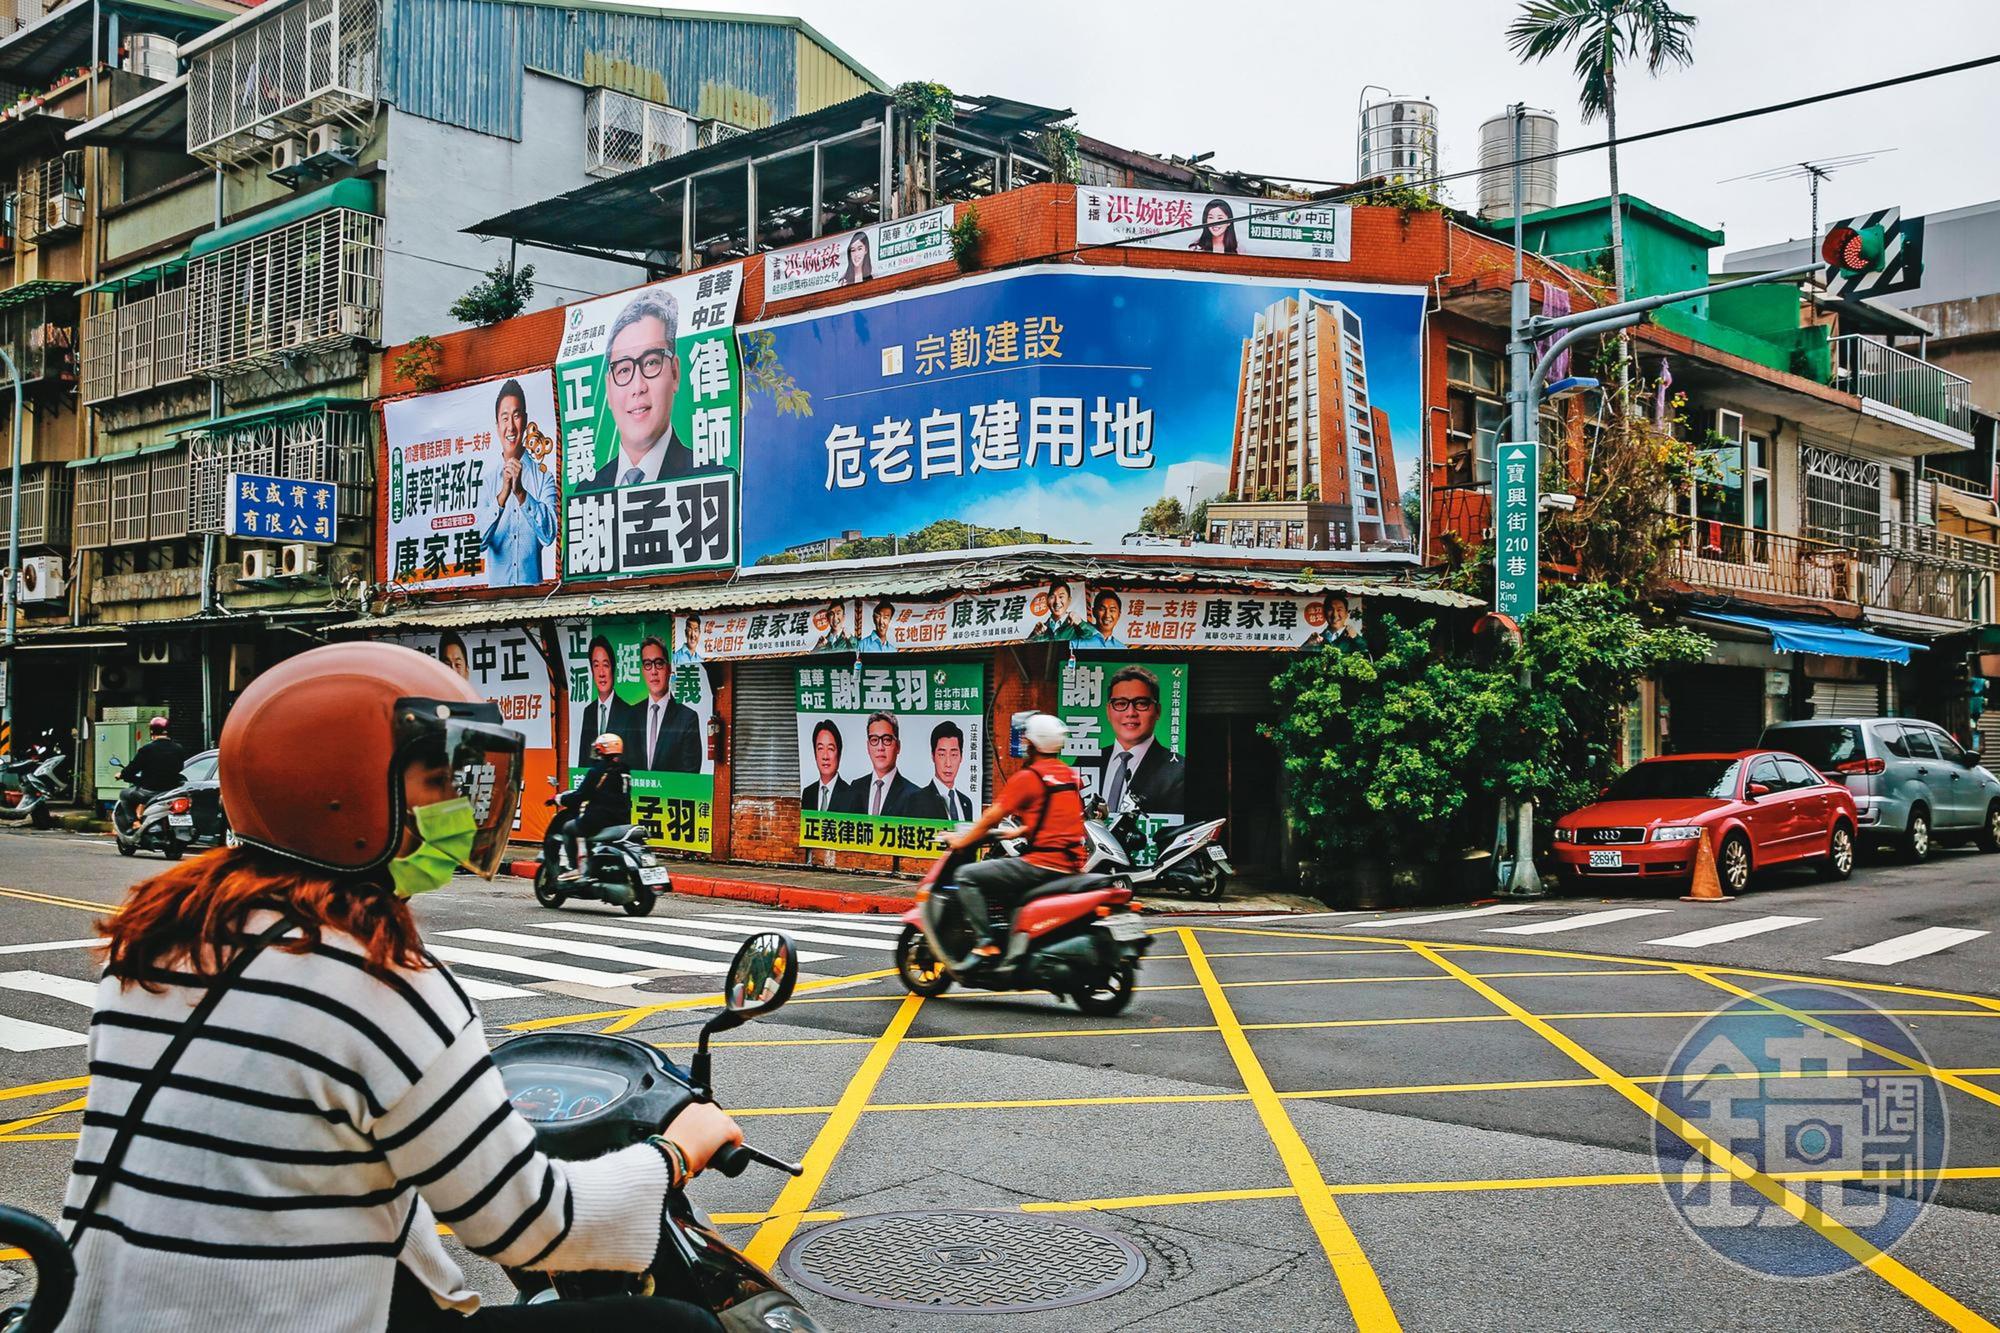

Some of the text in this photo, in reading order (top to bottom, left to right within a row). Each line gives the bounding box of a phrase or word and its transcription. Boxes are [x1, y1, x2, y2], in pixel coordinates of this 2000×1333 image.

[1088, 195, 1100, 221] 主播
[1107, 194, 1193, 227] 洪婉臻
[1306, 211, 1330, 225] 中正
[882, 217, 938, 242] 萬華 中正
[785, 242, 840, 279] 洪婉臻
[697, 269, 734, 301] 萬華
[691, 303, 727, 331] 中正
[915, 316, 1064, 376] 宗勤建設
[689, 337, 731, 469] 律師
[561, 364, 597, 486] 正義
[455, 432, 491, 454] 唯一支持
[824, 396, 1156, 491] 危老自建用地
[404, 459, 484, 517] 康寧祥孫仔
[242, 509, 329, 539] 有限公司
[568, 479, 729, 575] 謝孟羽
[394, 529, 483, 581] 康家瑋
[1500, 581, 1515, 590] Bao
[1500, 592, 1517, 603] Xing
[747, 610, 810, 640] 康家瑋
[952, 595, 1027, 628] 康家瑋
[1127, 600, 1197, 618] 瑋一支持
[1202, 598, 1298, 630] 康家瑋
[970, 629, 981, 638] 中正
[1205, 632, 1293, 641] 萬華 中正 市議員候選人
[473, 638, 529, 684] 中正
[567, 625, 590, 703] 正派
[616, 643, 641, 683] 挺
[799, 669, 825, 687] 萬華
[830, 668, 929, 711] 謝孟羽
[934, 687, 979, 698] 台北市議員
[801, 692, 826, 710] 中正
[934, 700, 970, 711] 擬參選人
[1169, 681, 1180, 763] 台北市議員擬參選人
[970, 723, 978, 760] 立法委員
[636, 795, 696, 843] 孟羽
[699, 802, 710, 843] 律師
[804, 818, 874, 846] 正義律師
